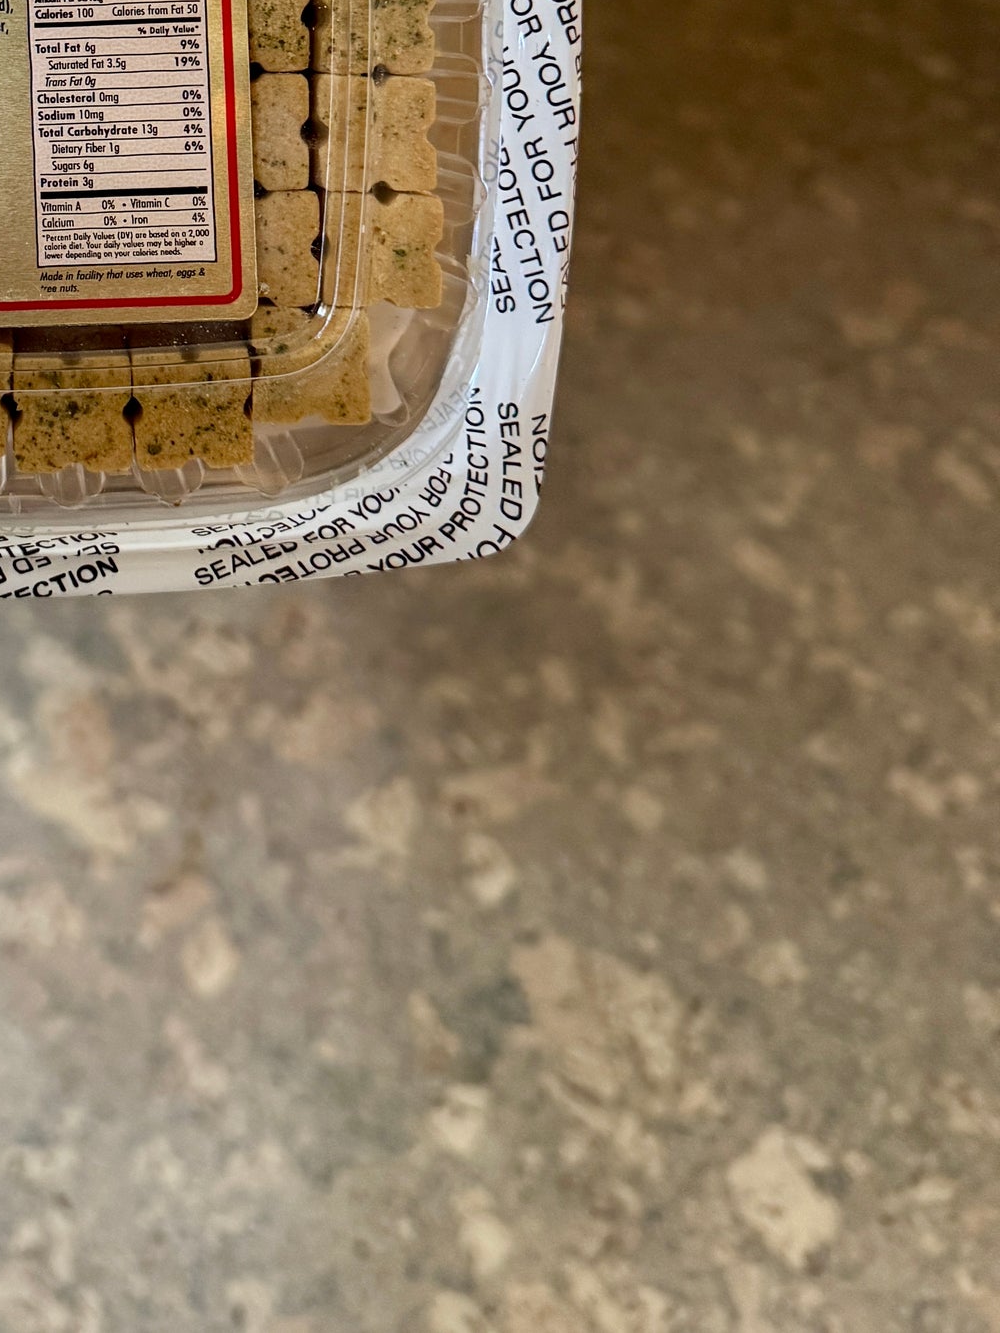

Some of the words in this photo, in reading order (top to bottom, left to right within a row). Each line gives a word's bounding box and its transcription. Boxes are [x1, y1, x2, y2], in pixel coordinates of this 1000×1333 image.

[35, 8, 73, 19] Calories
[77, 8, 94, 18] 100
[112, 5, 145, 17] Calories
[148, 4, 168, 15] from
[171, 4, 184, 14] Fat
[187, 4, 198, 14] 50
[149, 26, 170, 36] Daily
[35, 42, 61, 54] Total
[64, 42, 81, 53] Fat
[85, 42, 96, 54] 6g
[180, 39, 200, 50] 9%
[48, 58, 89, 70] Saturated
[91, 58, 104, 69] Fat
[107, 57, 126, 70] 3.5g
[174, 56, 200, 67] 19%
[45, 77, 67, 87] Trans
[69, 76, 83, 86] Fat
[85, 75, 96, 88] 0g
[532, 42, 576, 129] YOUR
[37, 91, 95, 104] Cholesterol
[99, 91, 119, 104] 0mg
[182, 89, 202, 100] 0%
[38, 110, 75, 121] Sodium
[79, 109, 104, 121] 10mg
[183, 106, 202, 117] 0%
[38, 126, 64, 138] Total
[67, 124, 138, 138] Carbohydrate
[142, 123, 158, 136] 13g
[183, 123, 203, 134] 4%
[52, 144, 83, 155] Dietary
[85, 142, 106, 153] Fiber
[109, 142, 120, 154] 1g
[184, 140, 204, 151] 6%
[52, 160, 81, 173] Sugars
[83, 159, 94, 172] 6g
[40, 177, 78, 188] Protein
[83, 176, 94, 189] 3g
[41, 202, 73, 212] Vitamin
[75, 201, 81, 211] A
[102, 199, 115, 210] 0%
[130, 198, 162, 209] Vitamin
[164, 197, 170, 208] C
[192, 196, 206, 206] 0%
[42, 217, 74, 228] Calcium
[103, 216, 117, 226] 0%
[131, 214, 148, 224] Iron
[192, 212, 205, 223] 4%
[40, 270, 63, 281] Made
[65, 271, 74, 281] in
[76, 270, 105, 282] facility
[106, 269, 123, 279] that
[126, 271, 144, 279] uses
[146, 267, 173, 279] wheat,
[176, 269, 196, 279] eggs
[498, 403, 523, 521] SEALED
[367, 534, 443, 573] YOUR
[194, 541, 297, 585] SEALED
